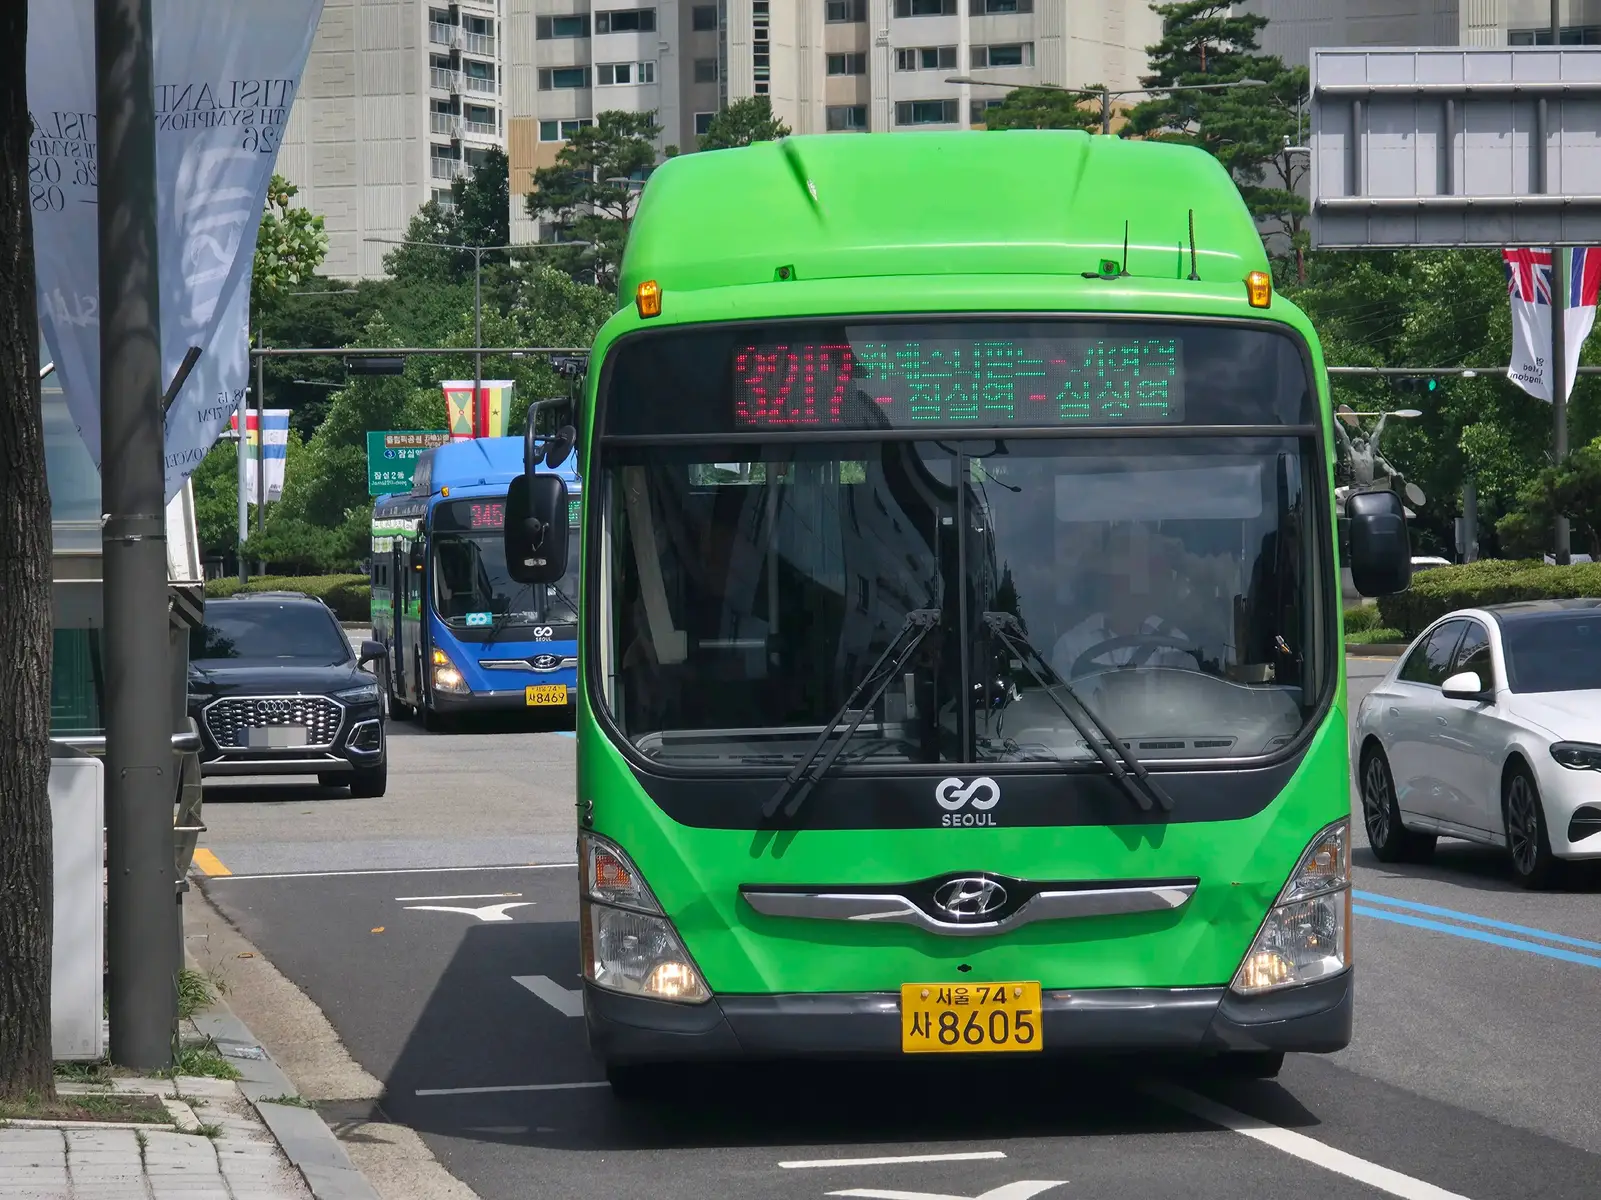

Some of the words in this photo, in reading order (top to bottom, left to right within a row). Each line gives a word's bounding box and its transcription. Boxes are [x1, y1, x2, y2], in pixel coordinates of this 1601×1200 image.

[735, 344, 852, 423] 3217
[909, 382, 1014, 420] 잠실역
[1056, 379, 1168, 418] 삼성역
[533, 626, 553, 637] GO
[935, 777, 1001, 811] GO
[941, 814, 997, 827] SEOUL
[936, 987, 970, 1006] 서울
[976, 987, 1008, 1005] 74
